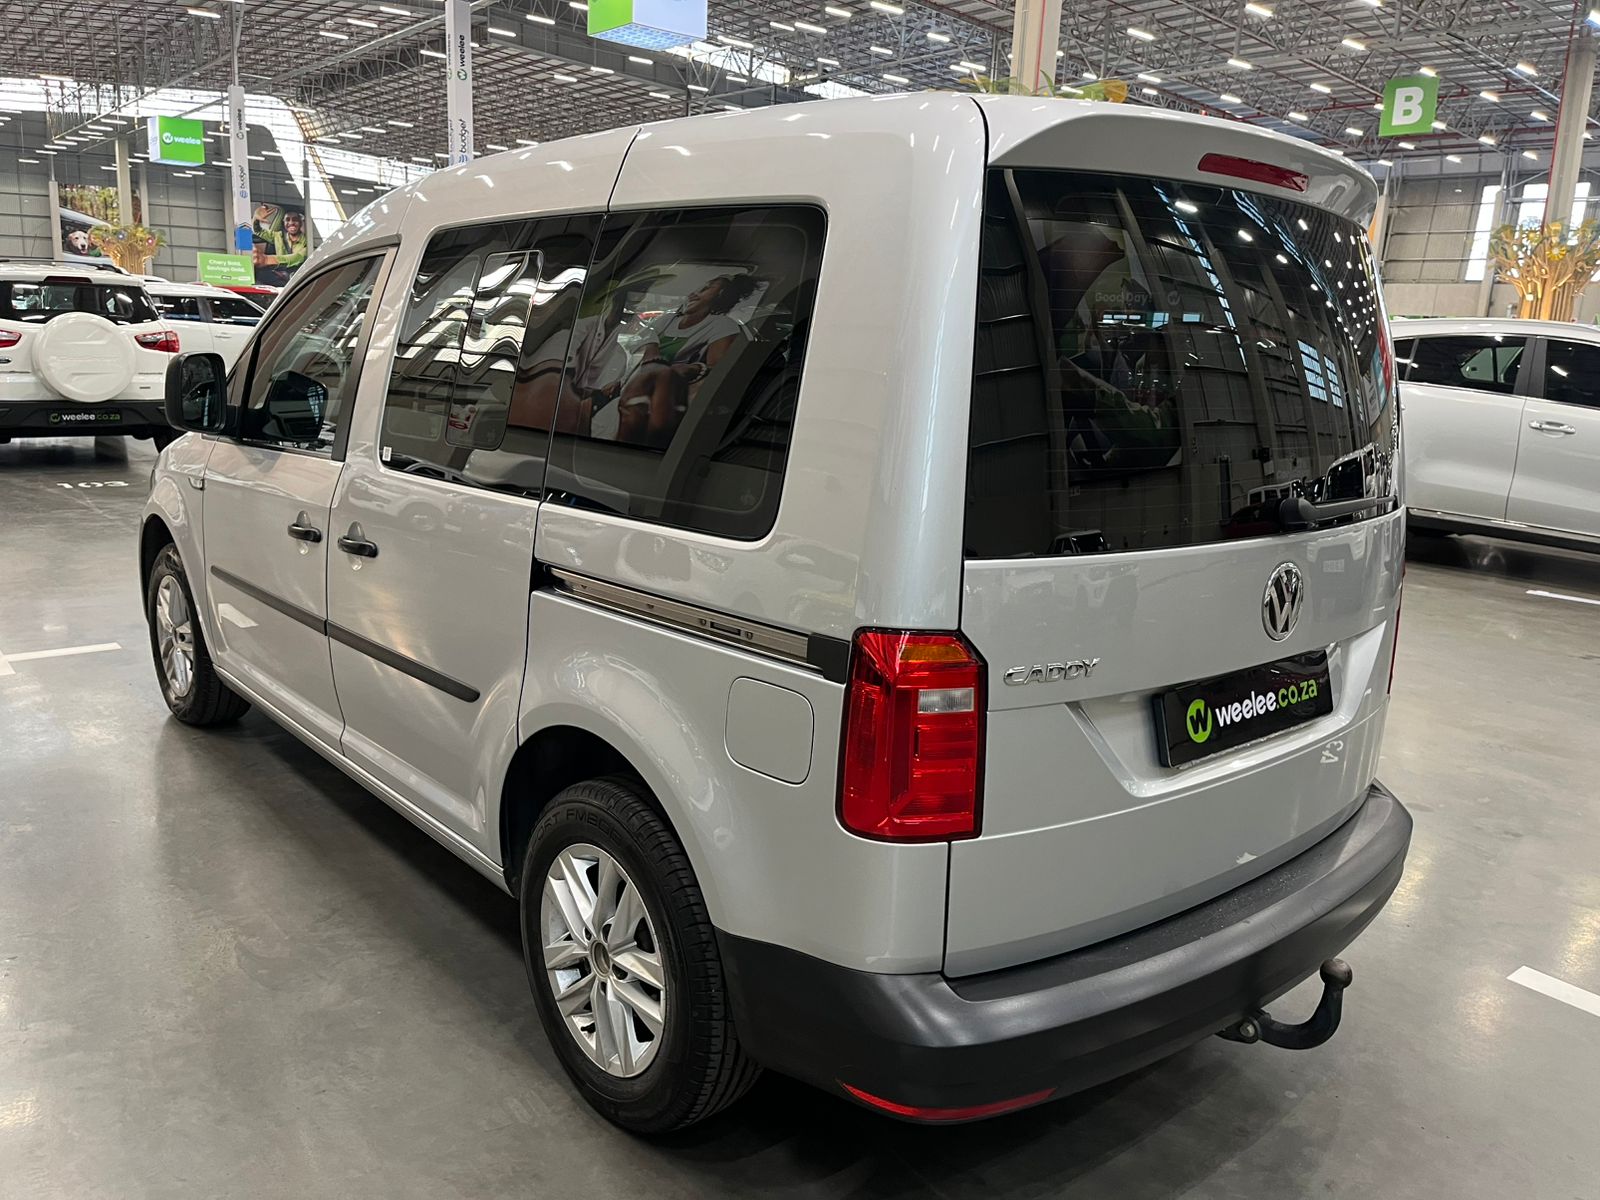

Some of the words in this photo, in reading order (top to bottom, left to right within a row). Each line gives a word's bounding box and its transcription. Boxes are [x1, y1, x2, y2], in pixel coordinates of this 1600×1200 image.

[457, 34, 466, 67] weelee
[1391, 86, 1425, 126] B
[174, 136, 201, 145] weelee
[459, 119, 468, 153] budget
[1003, 657, 1101, 687] CADDY
[1215, 675, 1319, 728] weelee.co.za
